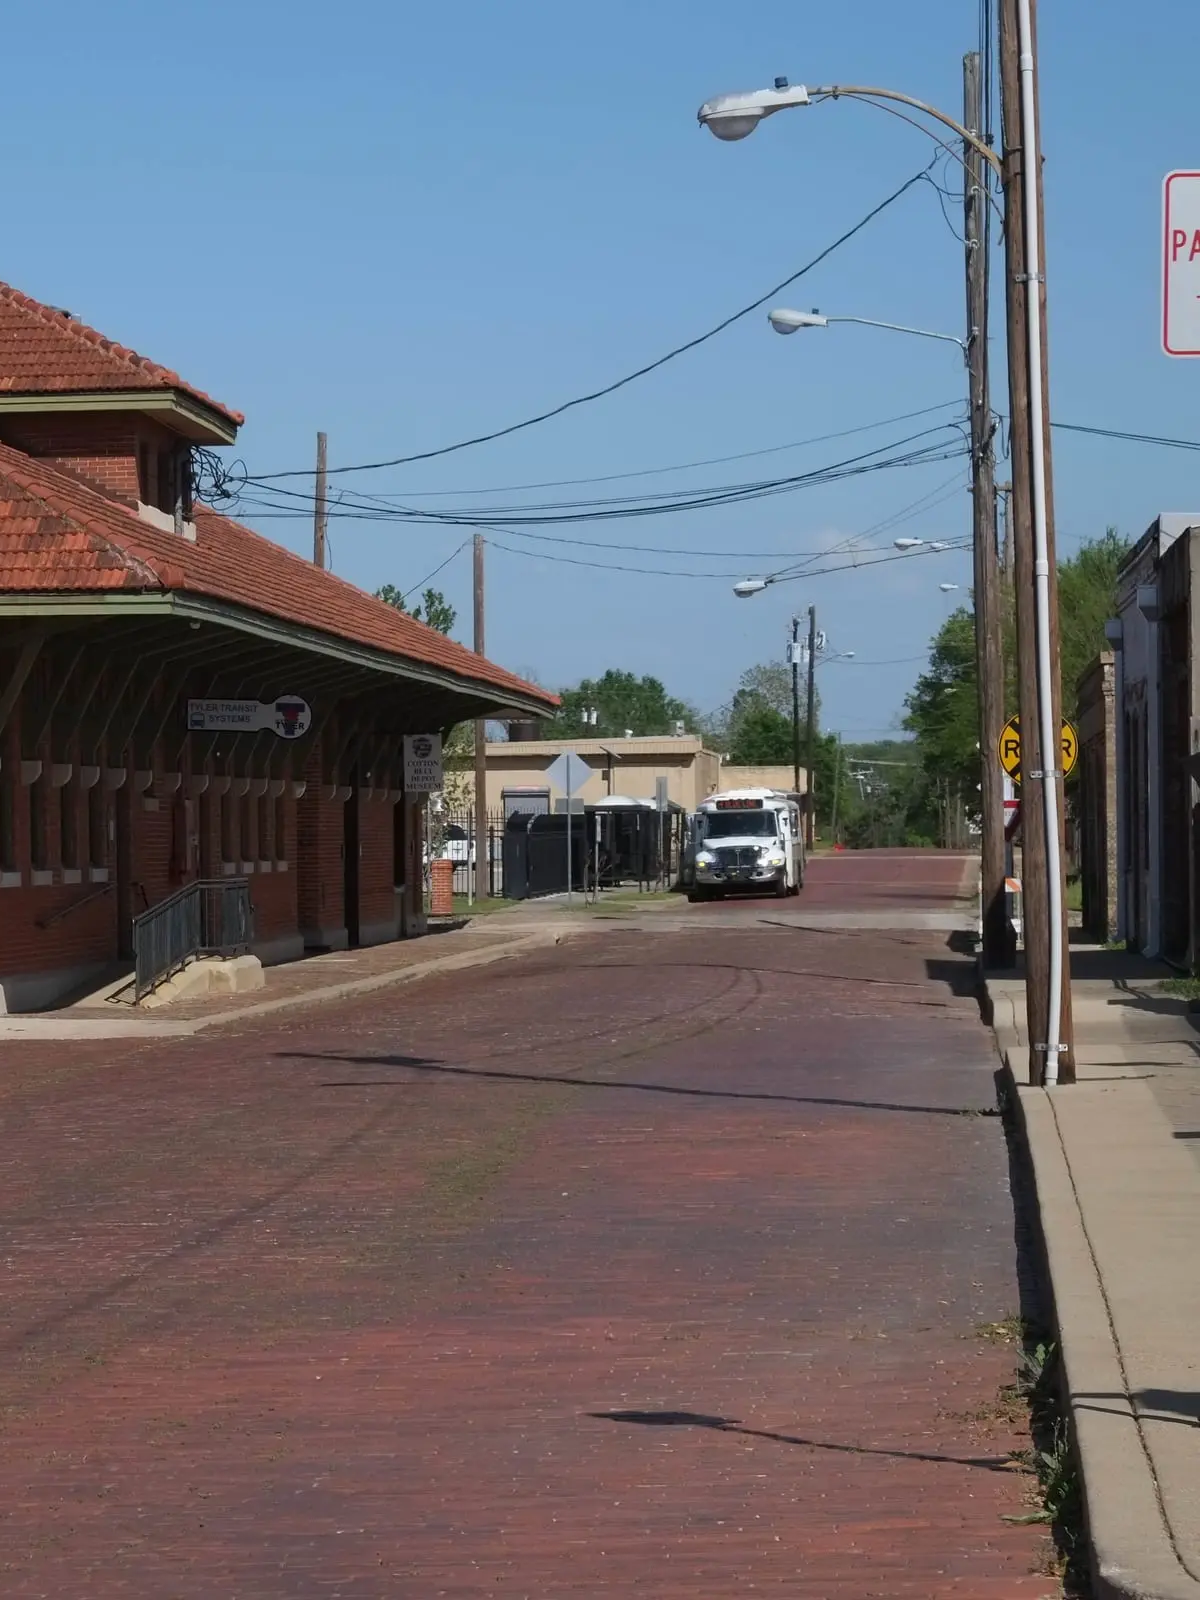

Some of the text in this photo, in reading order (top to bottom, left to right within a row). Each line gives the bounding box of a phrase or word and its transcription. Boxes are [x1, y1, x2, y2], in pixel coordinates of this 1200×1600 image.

[190, 703, 258, 713] TYLER TRANSIT
[208, 714, 251, 723] SYSTEMS
[275, 721, 305, 731] TYER
[1004, 739, 1019, 758] R
